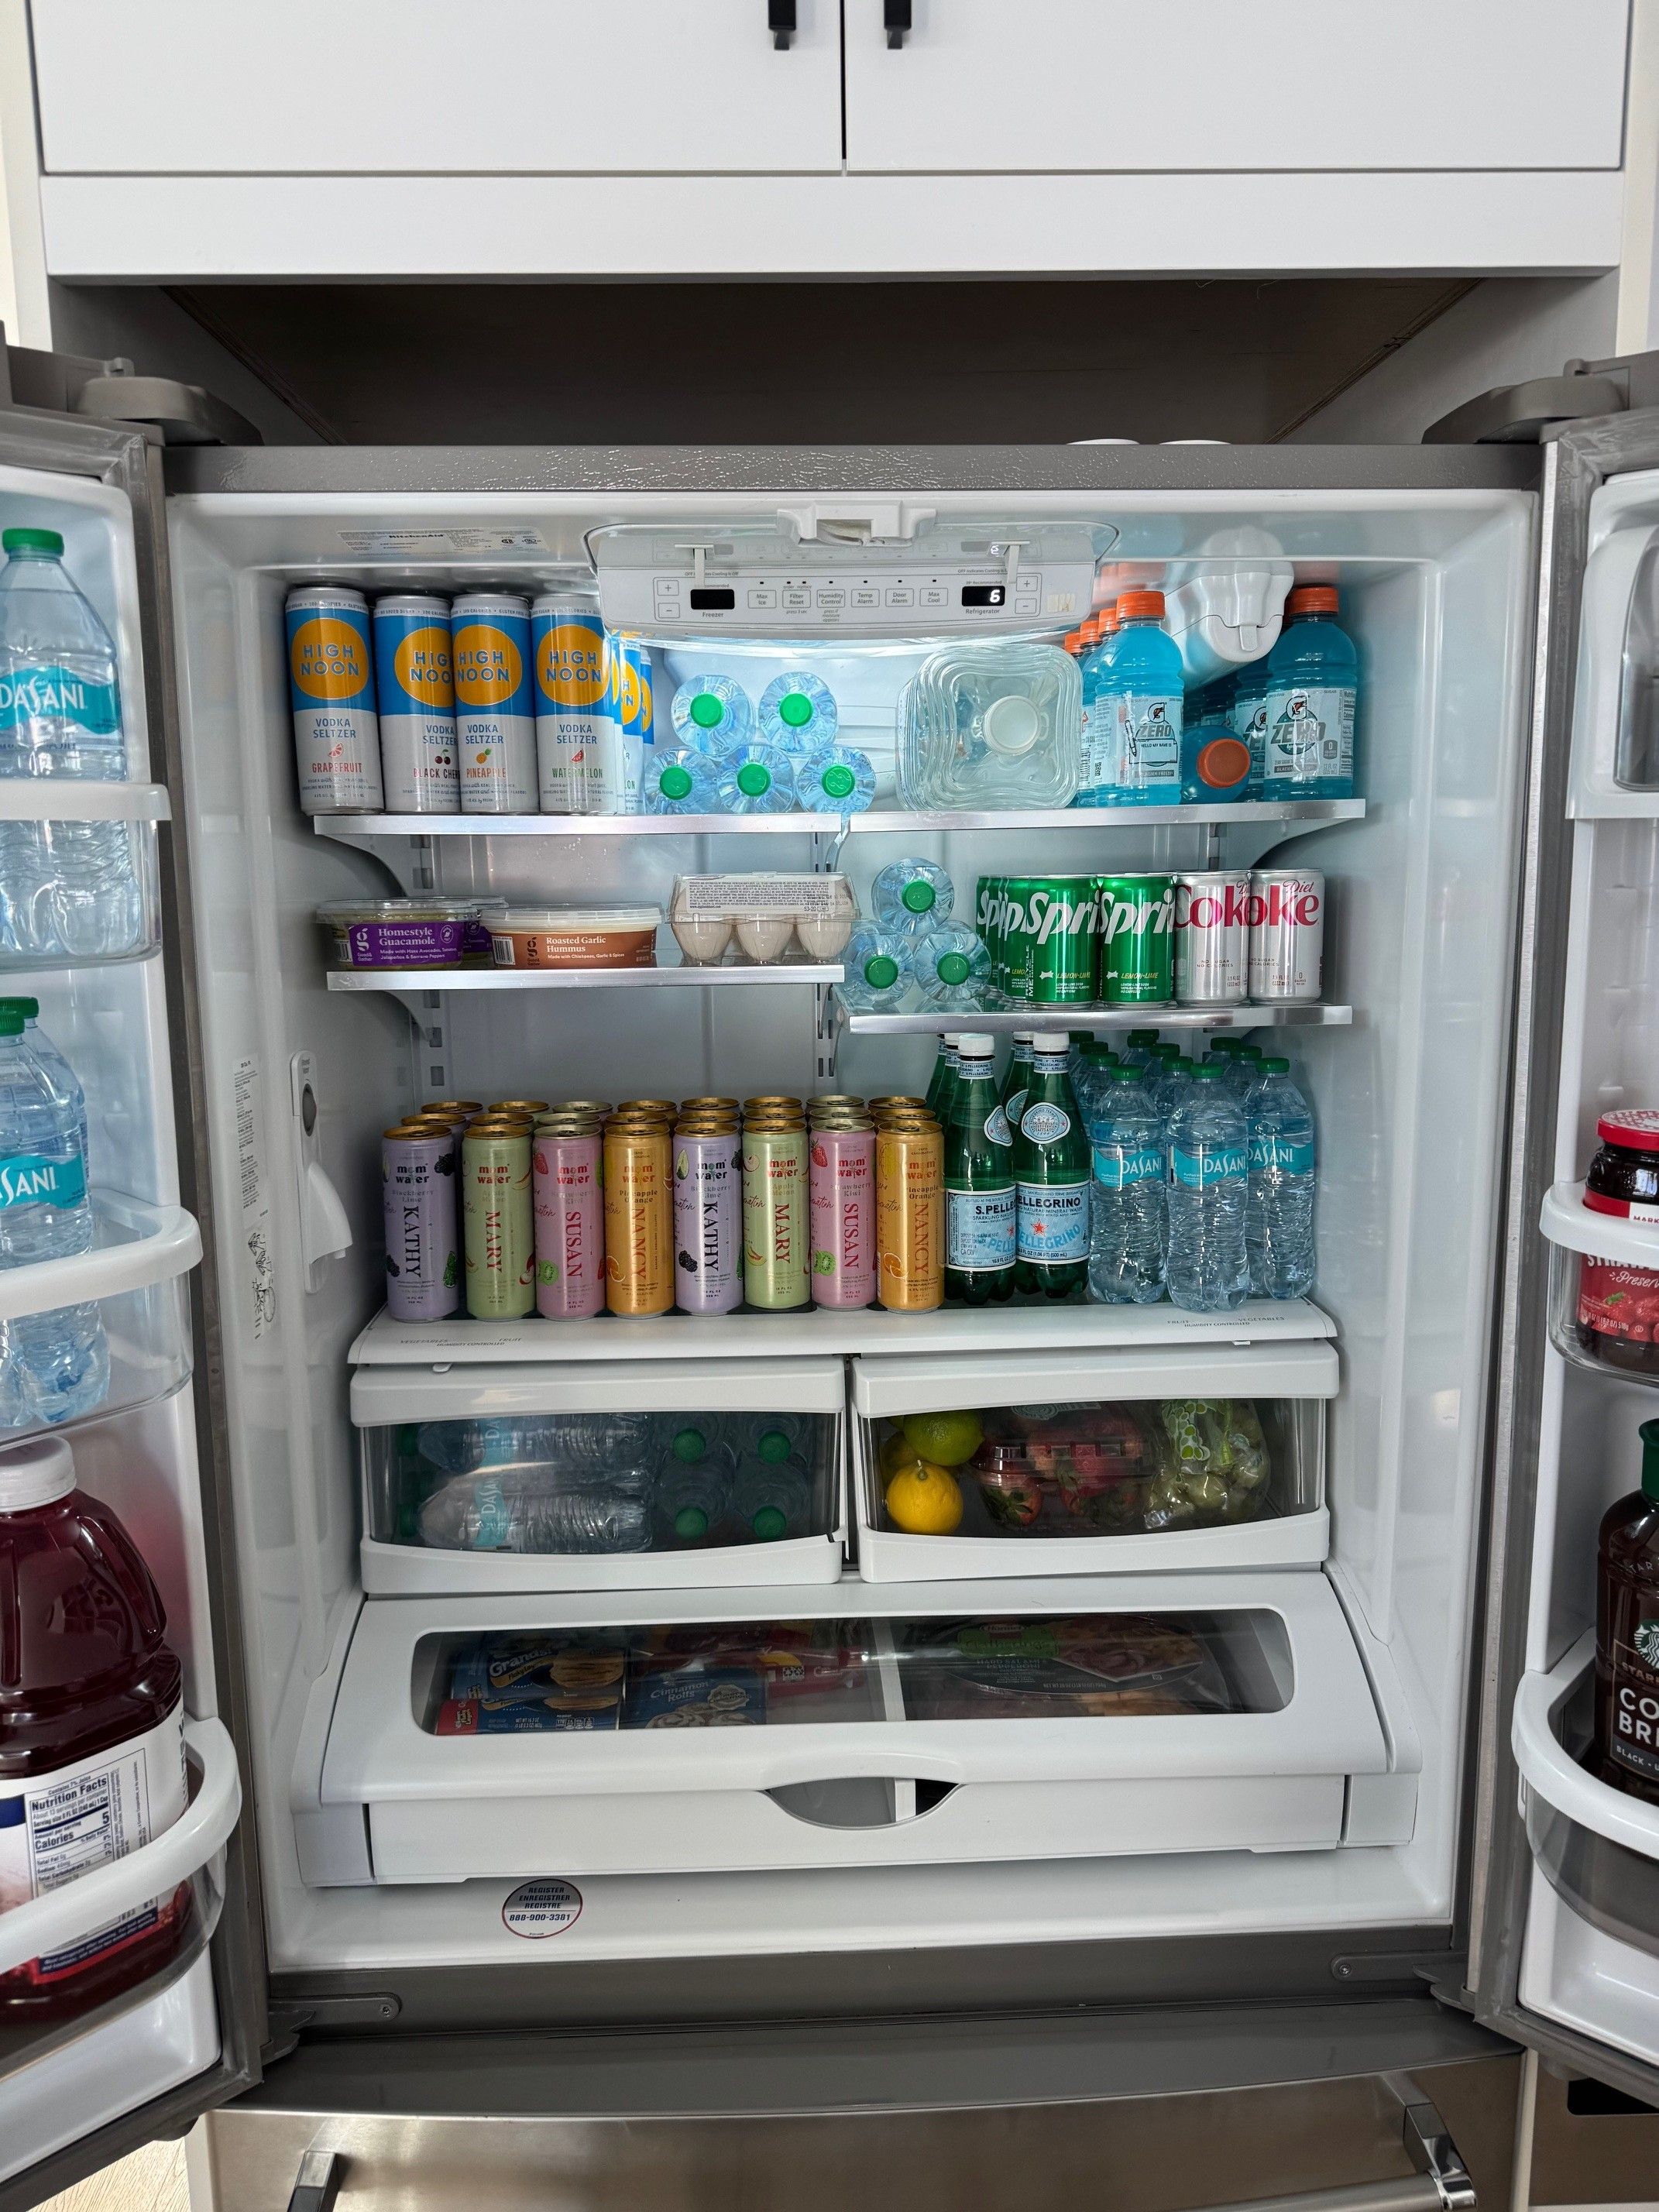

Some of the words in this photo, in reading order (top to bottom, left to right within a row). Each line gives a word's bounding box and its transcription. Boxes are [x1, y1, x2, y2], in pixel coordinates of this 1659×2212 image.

[989, 589, 1001, 603] 6
[303, 644, 354, 658] HIGH
[458, 650, 505, 665] HIGH
[548, 650, 597, 665] HIGH
[414, 651, 452, 667] HIG
[300, 660, 359, 677] NOON
[410, 667, 453, 685] NOO
[456, 668, 510, 683] NOON
[545, 668, 602, 684] NOON
[0, 675, 87, 715] DASANI
[315, 718, 351, 728] VODKA
[426, 725, 455, 734] VODKA
[467, 724, 498, 733] VODKA
[559, 724, 592, 733] VODKA
[313, 729, 356, 739] SELTZER
[1139, 724, 1172, 737] ZERO
[1270, 722, 1327, 745] ZERO
[465, 735, 503, 744] SELTZER
[556, 735, 597, 745] SELTZER
[312, 762, 362, 774] GRAPEFRUIT
[413, 768, 440, 778] BLACK
[466, 768, 507, 778] PINEAPPLE
[551, 768, 603, 778] WATERMELON
[1283, 879, 1314, 893] Diet
[1174, 884, 1249, 929] Cok
[1248, 885, 1320, 927] oke
[1026, 891, 1100, 945] Spri
[378, 928, 433, 938] Homestyle
[379, 936, 435, 946] Guacamole
[545, 936, 581, 945] Roasted
[838, 1157, 865, 1167] mom
[1248, 1145, 1294, 1167] DASANI
[397, 1164, 427, 1174] mom
[479, 1164, 509, 1174] mom
[558, 1164, 588, 1174] mom
[624, 1164, 654, 1173] mom
[698, 1161, 726, 1170] mom
[769, 1158, 796, 1168] mom
[908, 1161, 936, 1170] mm
[1122, 1156, 1162, 1178] DASANI
[1204, 1153, 1246, 1177] DASANI
[696, 1170, 728, 1180] water
[767, 1168, 799, 1178] water
[836, 1167, 867, 1177] water
[0, 1166, 57, 1206] SANI
[396, 1176, 430, 1184] water
[477, 1176, 511, 1184] water
[557, 1176, 590, 1185] water
[622, 1175, 655, 1184] water
[908, 1192, 936, 1200] Orange
[1018, 1195, 1081, 1208] ELLEGRINO
[975, 1199, 1015, 1215] S.PELLE
[1633, 1215, 1659, 1224] MARK
[703, 1200, 719, 1272] KATHY
[775, 1203, 791, 1264] MARY
[844, 1203, 860, 1269] SUSAN
[915, 1203, 929, 1275] NANCY
[1018, 1224, 1081, 1249] ELLEGRINO
[403, 1206, 421, 1278] KATHY
[486, 1210, 503, 1273] MARY
[565, 1211, 582, 1278] SUSAN
[631, 1207, 647, 1279] NANCY
[650, 1681, 709, 1698] Cinnamon
[668, 1690, 696, 1703] Rolls
[1620, 1687, 1659, 1720] CO
[1616, 1744, 1644, 1767] BLACK
[32, 1787, 78, 1812] Nutrition
[79, 1777, 108, 1796] Facts
[35, 1831, 74, 1850] Calories
[101, 1811, 110, 1825] 5
[509, 1913, 571, 1922] 888-900-3381
